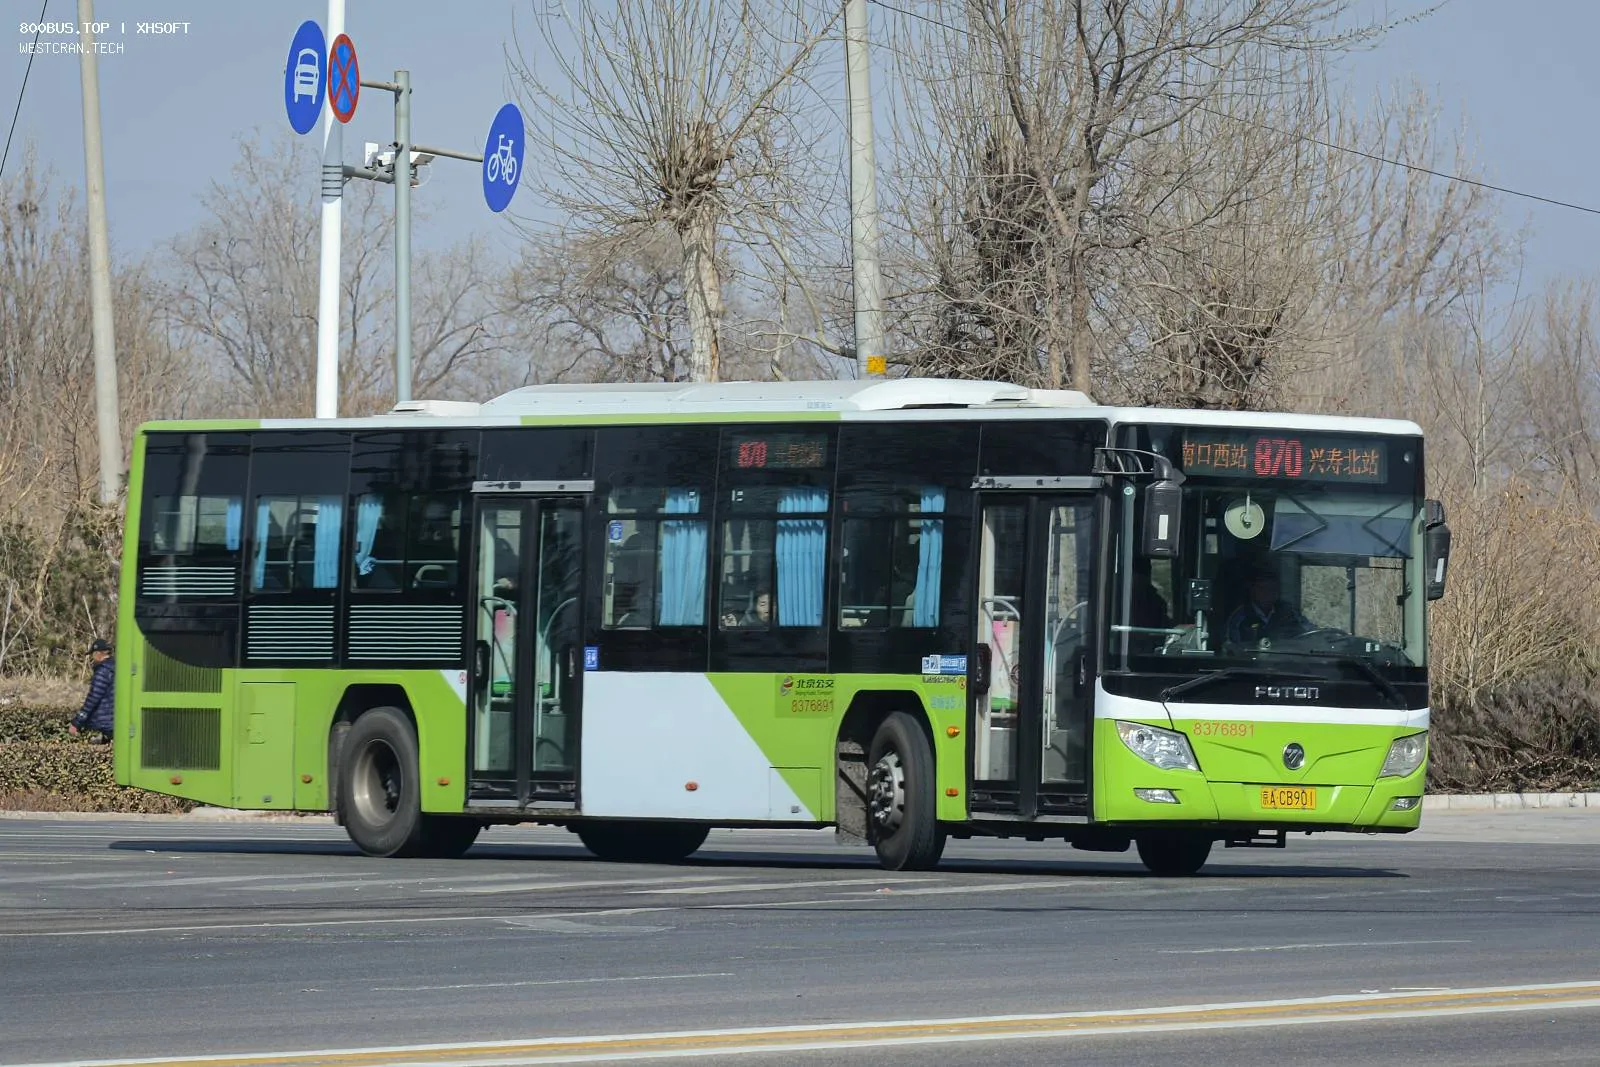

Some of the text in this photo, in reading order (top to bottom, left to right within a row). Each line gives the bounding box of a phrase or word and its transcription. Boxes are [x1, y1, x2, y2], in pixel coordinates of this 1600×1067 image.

[1182, 437, 1380, 478] 南口西站 870 兴寿北站
[796, 678, 835, 689] 北京公交
[791, 699, 834, 713] 8376891
[1193, 721, 1255, 738] 8376891
